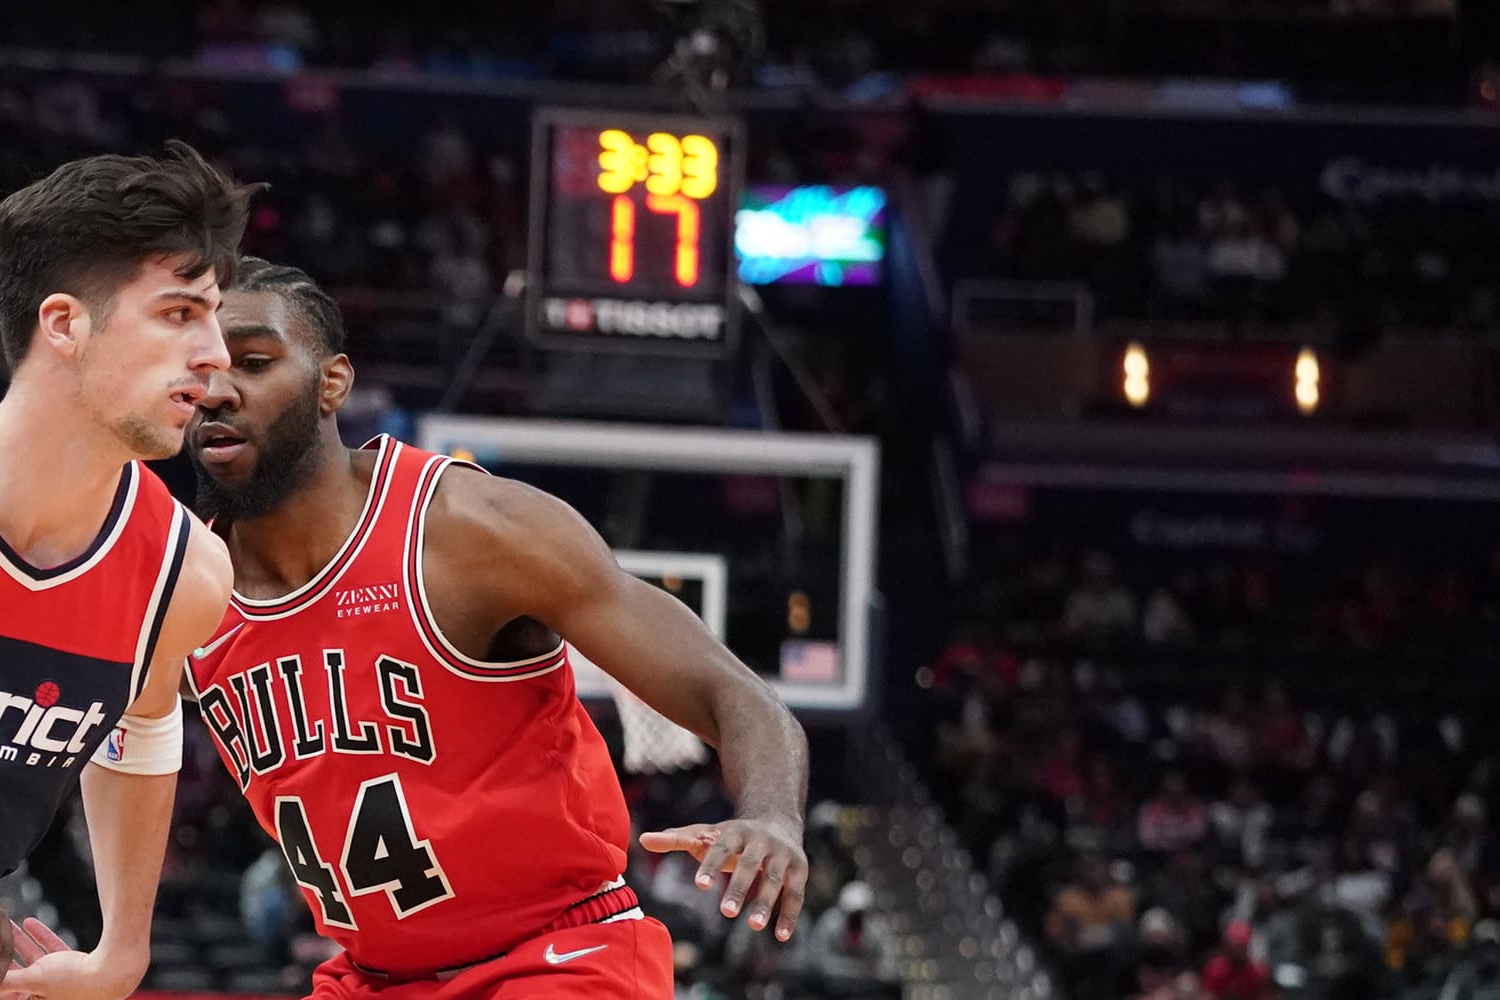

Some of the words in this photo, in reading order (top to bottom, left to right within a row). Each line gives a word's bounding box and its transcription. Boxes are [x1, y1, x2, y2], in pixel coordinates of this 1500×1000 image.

[597, 130, 718, 199] 3:33
[610, 194, 701, 287] 17
[336, 583, 398, 606] ZENNI
[337, 602, 399, 618] EYEWEAR
[199, 648, 436, 794] BULLS
[274, 772, 455, 931] 44
